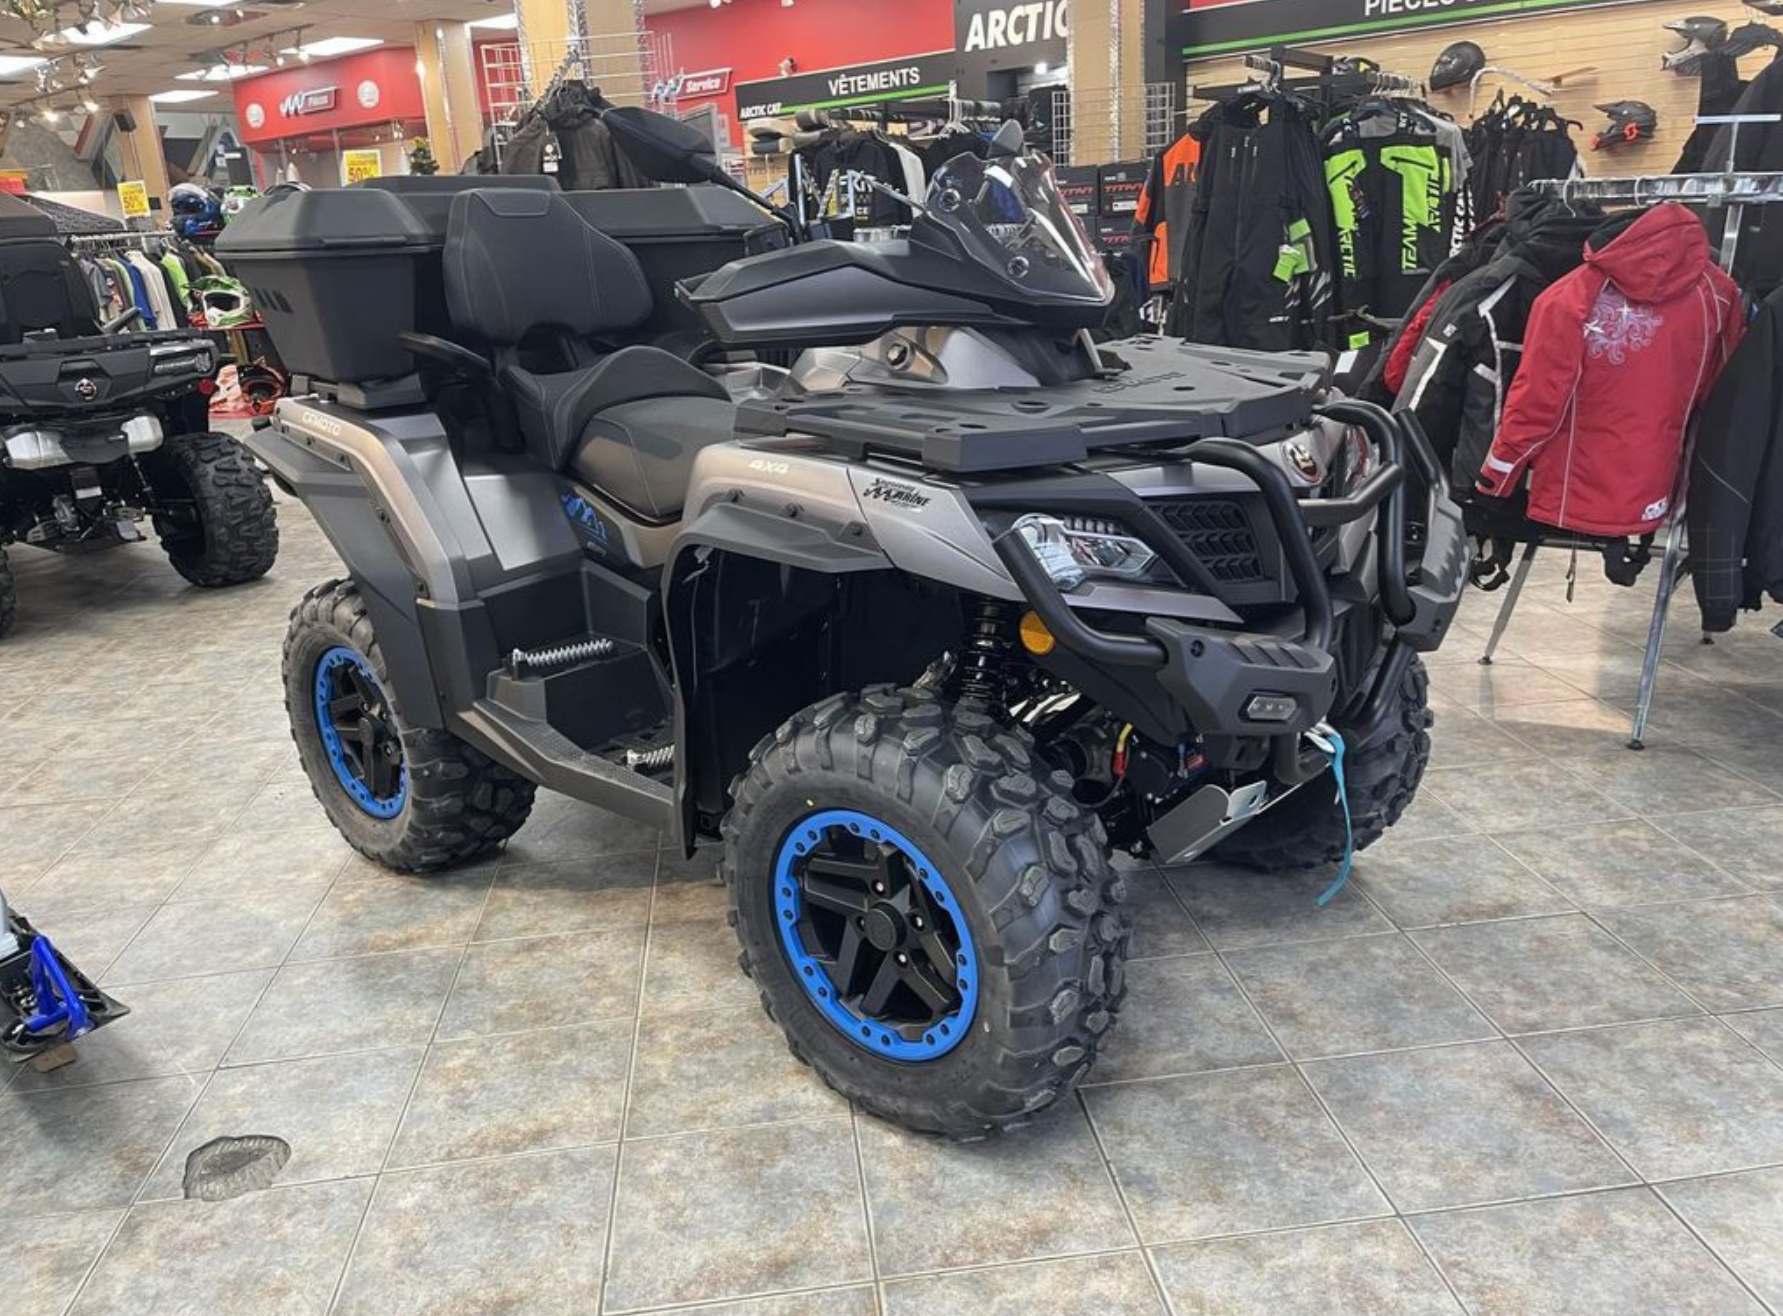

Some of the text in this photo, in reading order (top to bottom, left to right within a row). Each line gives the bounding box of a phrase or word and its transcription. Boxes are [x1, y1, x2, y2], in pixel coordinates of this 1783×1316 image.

[1364, 0, 1454, 16] PIE
[686, 76, 721, 93] Service
[828, 66, 920, 97] VÊTEMENTS
[740, 102, 782, 118] ARCTIC CAT
[1401, 214, 1419, 272] TEAM
